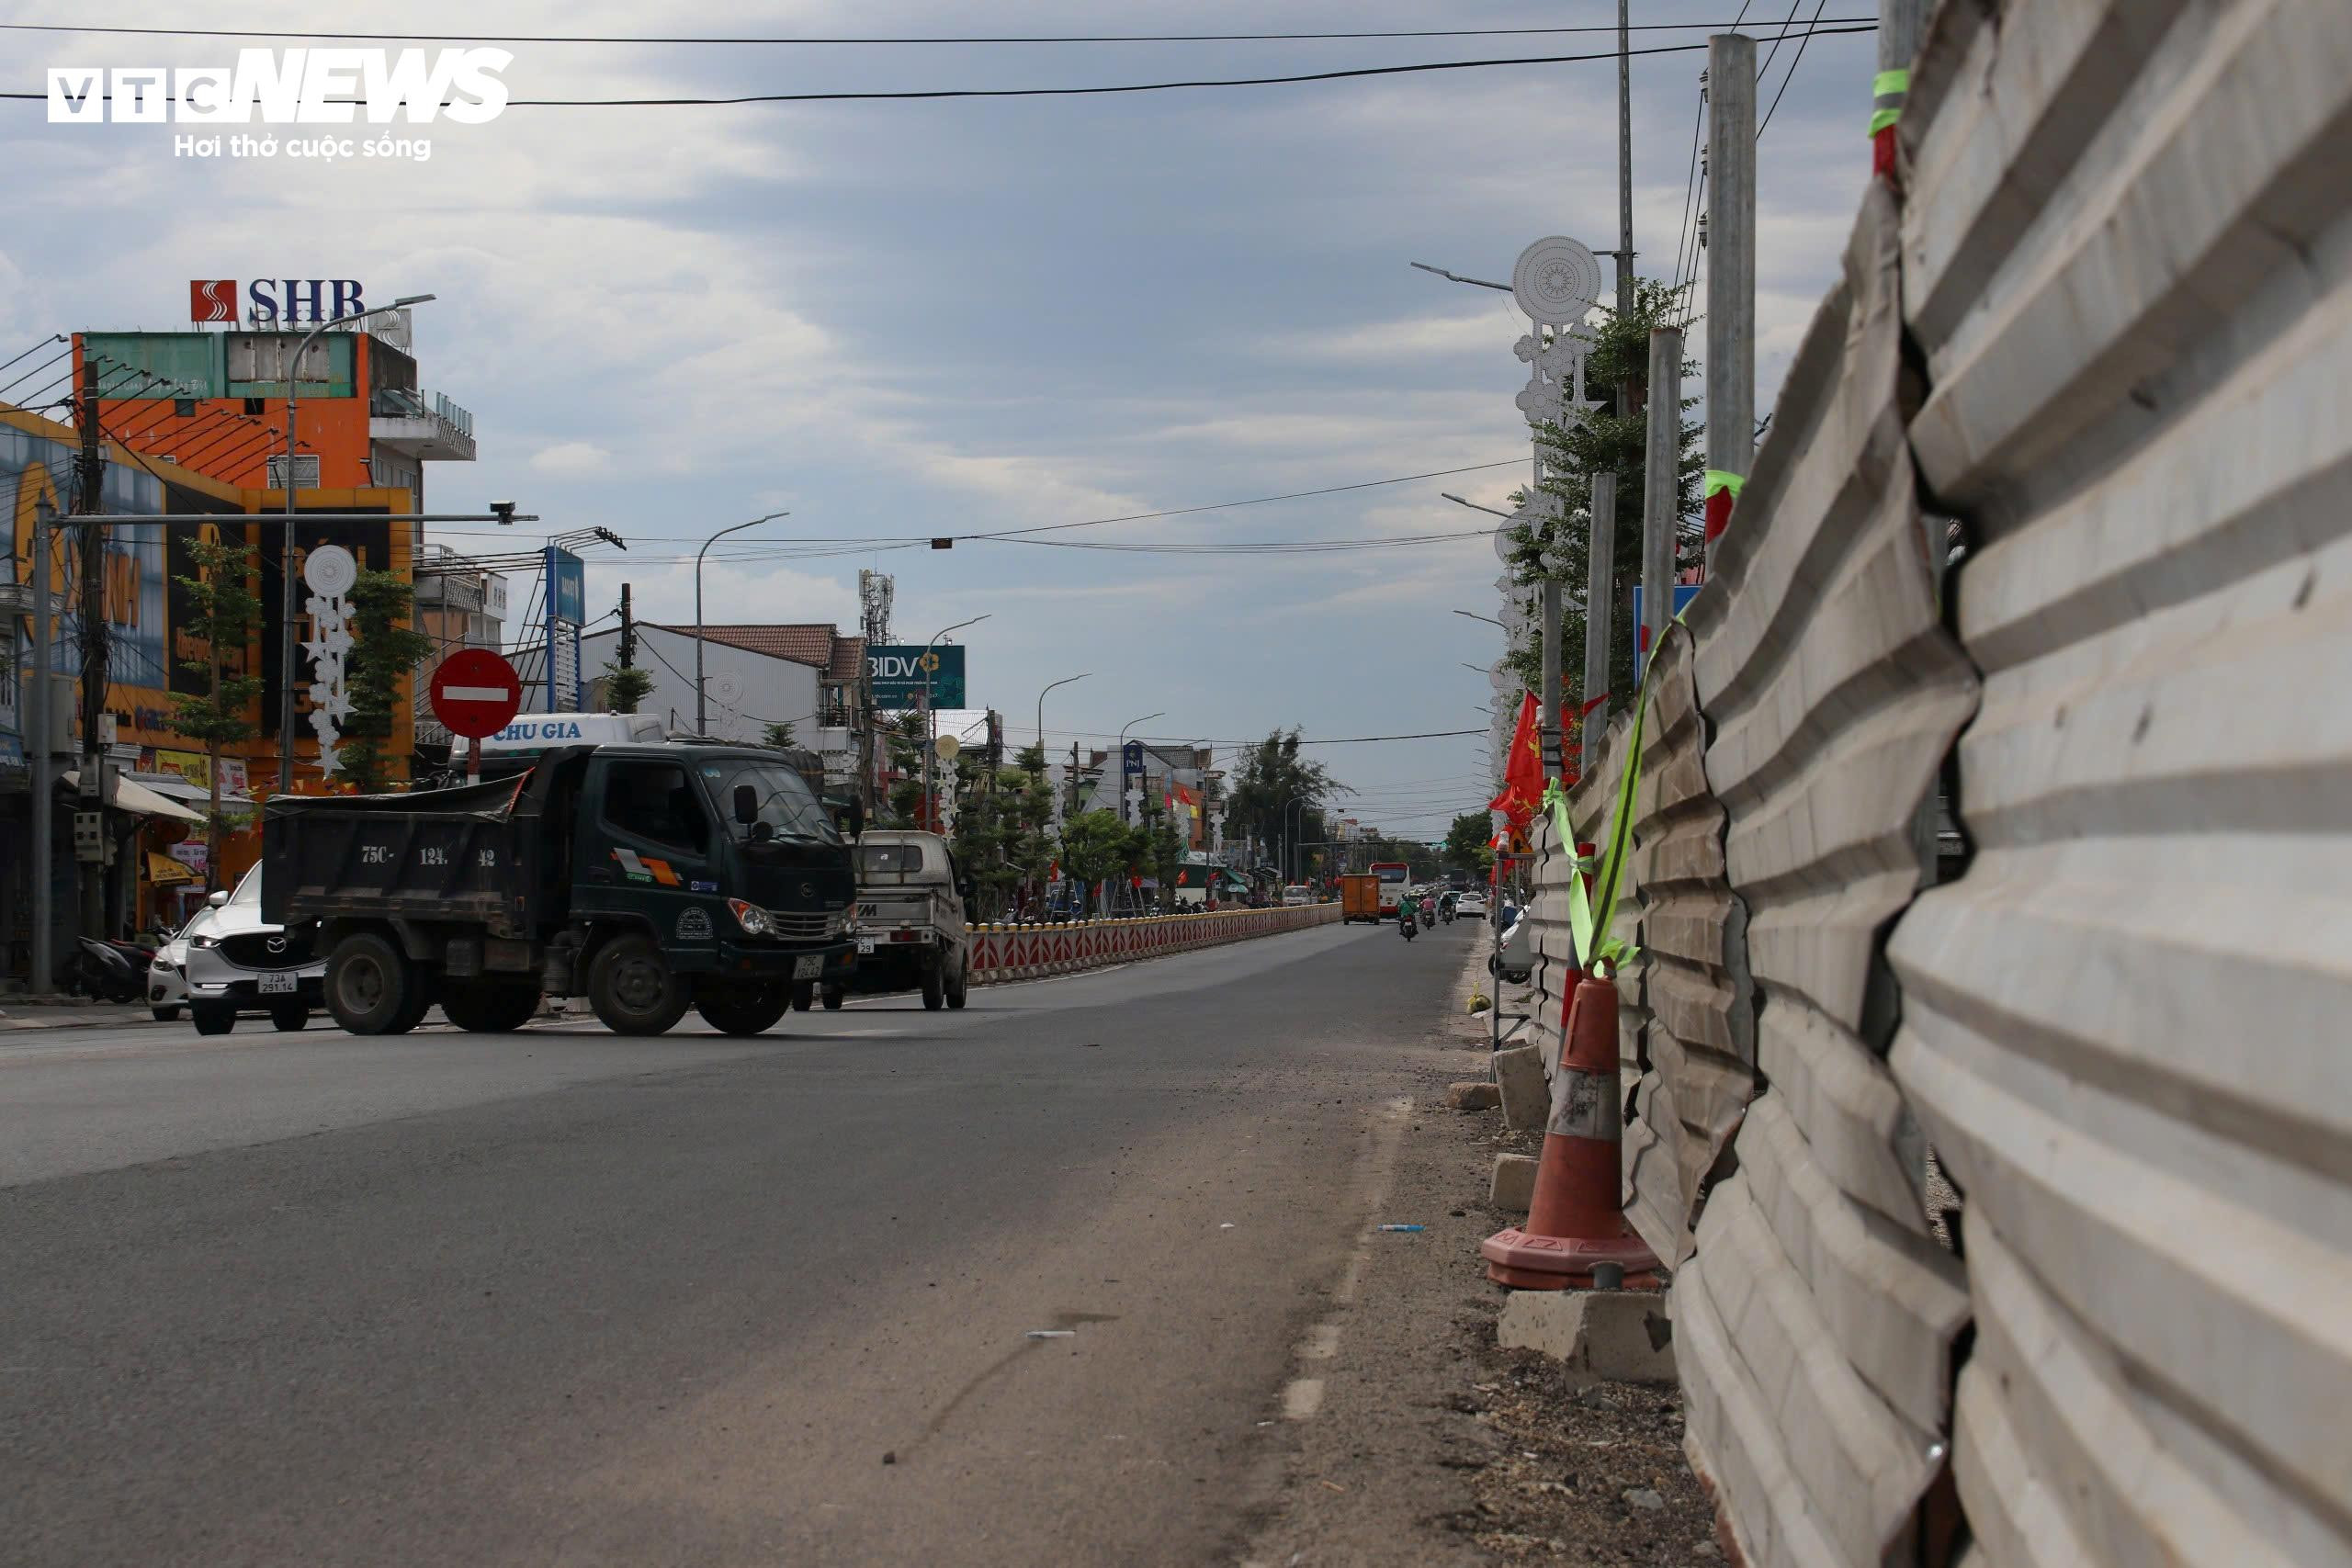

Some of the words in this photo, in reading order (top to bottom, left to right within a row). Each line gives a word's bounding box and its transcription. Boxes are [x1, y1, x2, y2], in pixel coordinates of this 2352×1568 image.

[249, 278, 366, 322] SHB
[867, 656, 920, 677] BIDV
[542, 722, 582, 739] GIA
[478, 849, 495, 867] 42
[268, 974, 286, 983] 73A
[262, 983, 293, 992] 291.14
